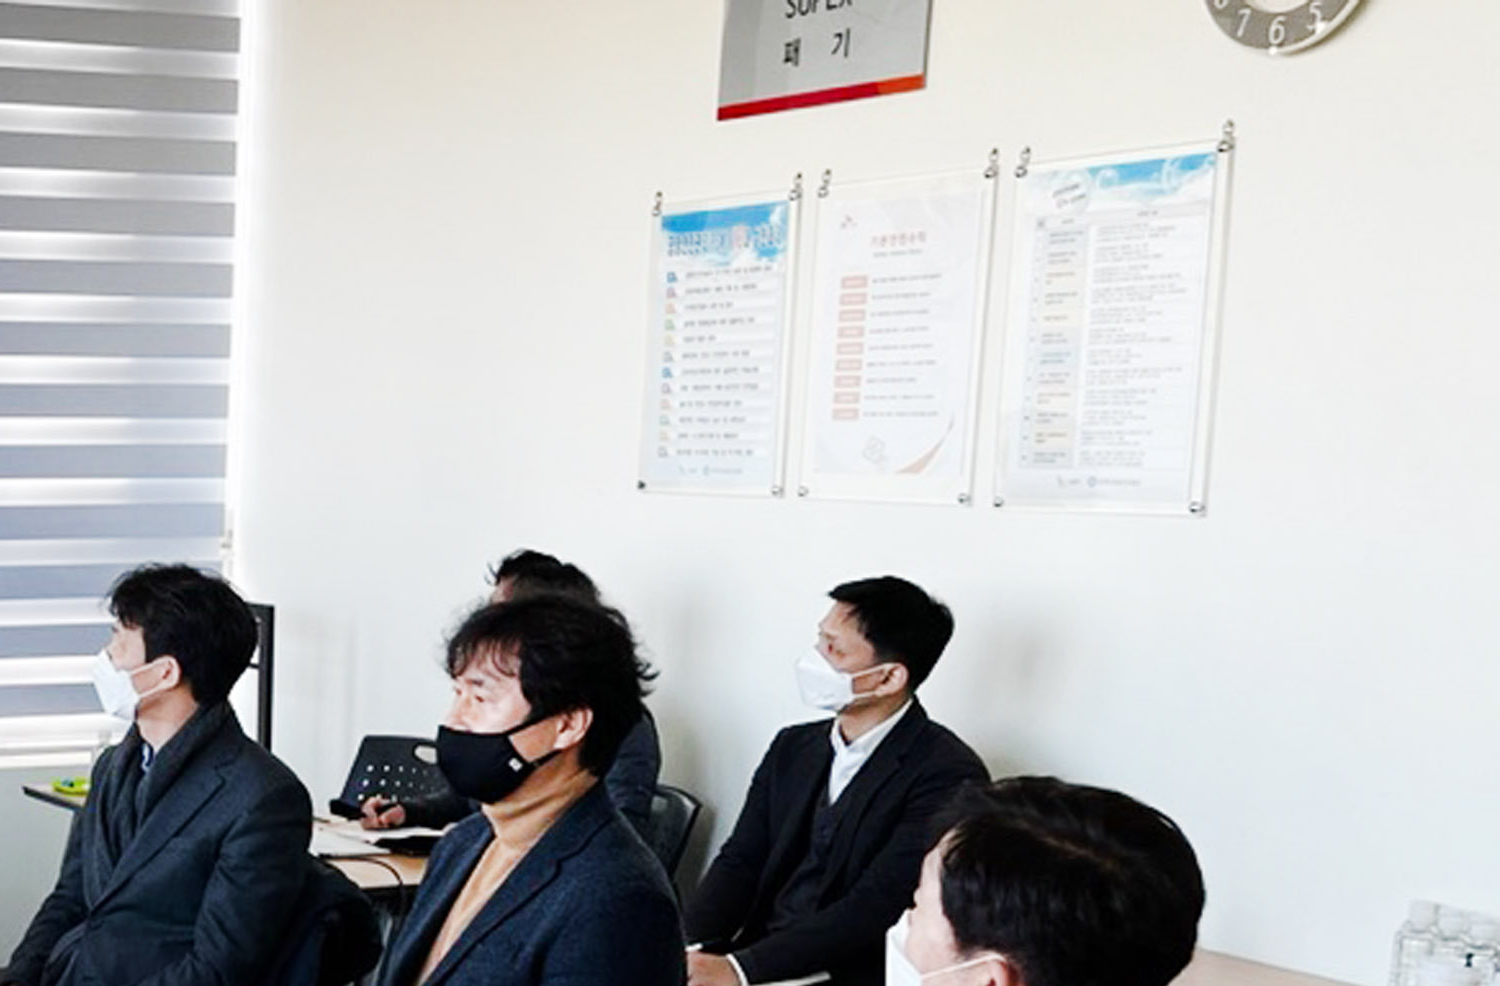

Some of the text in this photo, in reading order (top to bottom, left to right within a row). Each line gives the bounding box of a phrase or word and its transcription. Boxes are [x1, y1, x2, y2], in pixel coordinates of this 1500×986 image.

[786, 0, 852, 18] SUP
[1237, 9, 1251, 37] 7
[1268, 16, 1286, 44] 6
